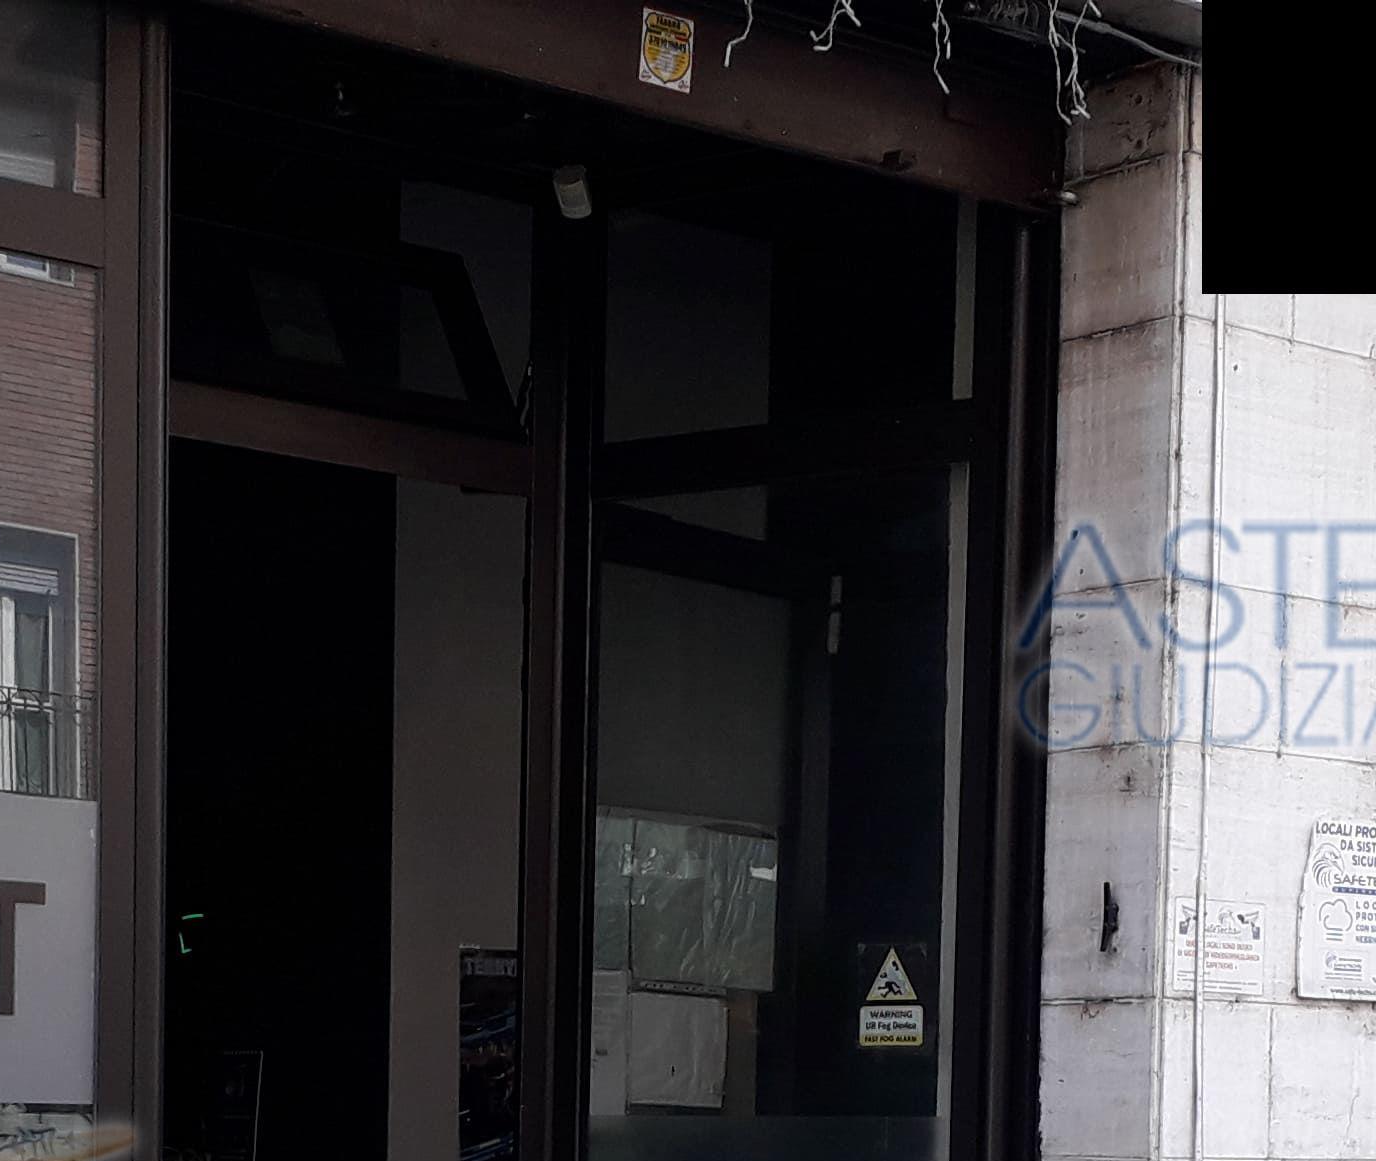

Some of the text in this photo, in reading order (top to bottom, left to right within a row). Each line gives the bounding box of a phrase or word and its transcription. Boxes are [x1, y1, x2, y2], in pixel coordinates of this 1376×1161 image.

[1315, 821, 1352, 837] LOCALI
[1340, 838, 1354, 851] DA
[870, 1011, 913, 1019] WARNING
